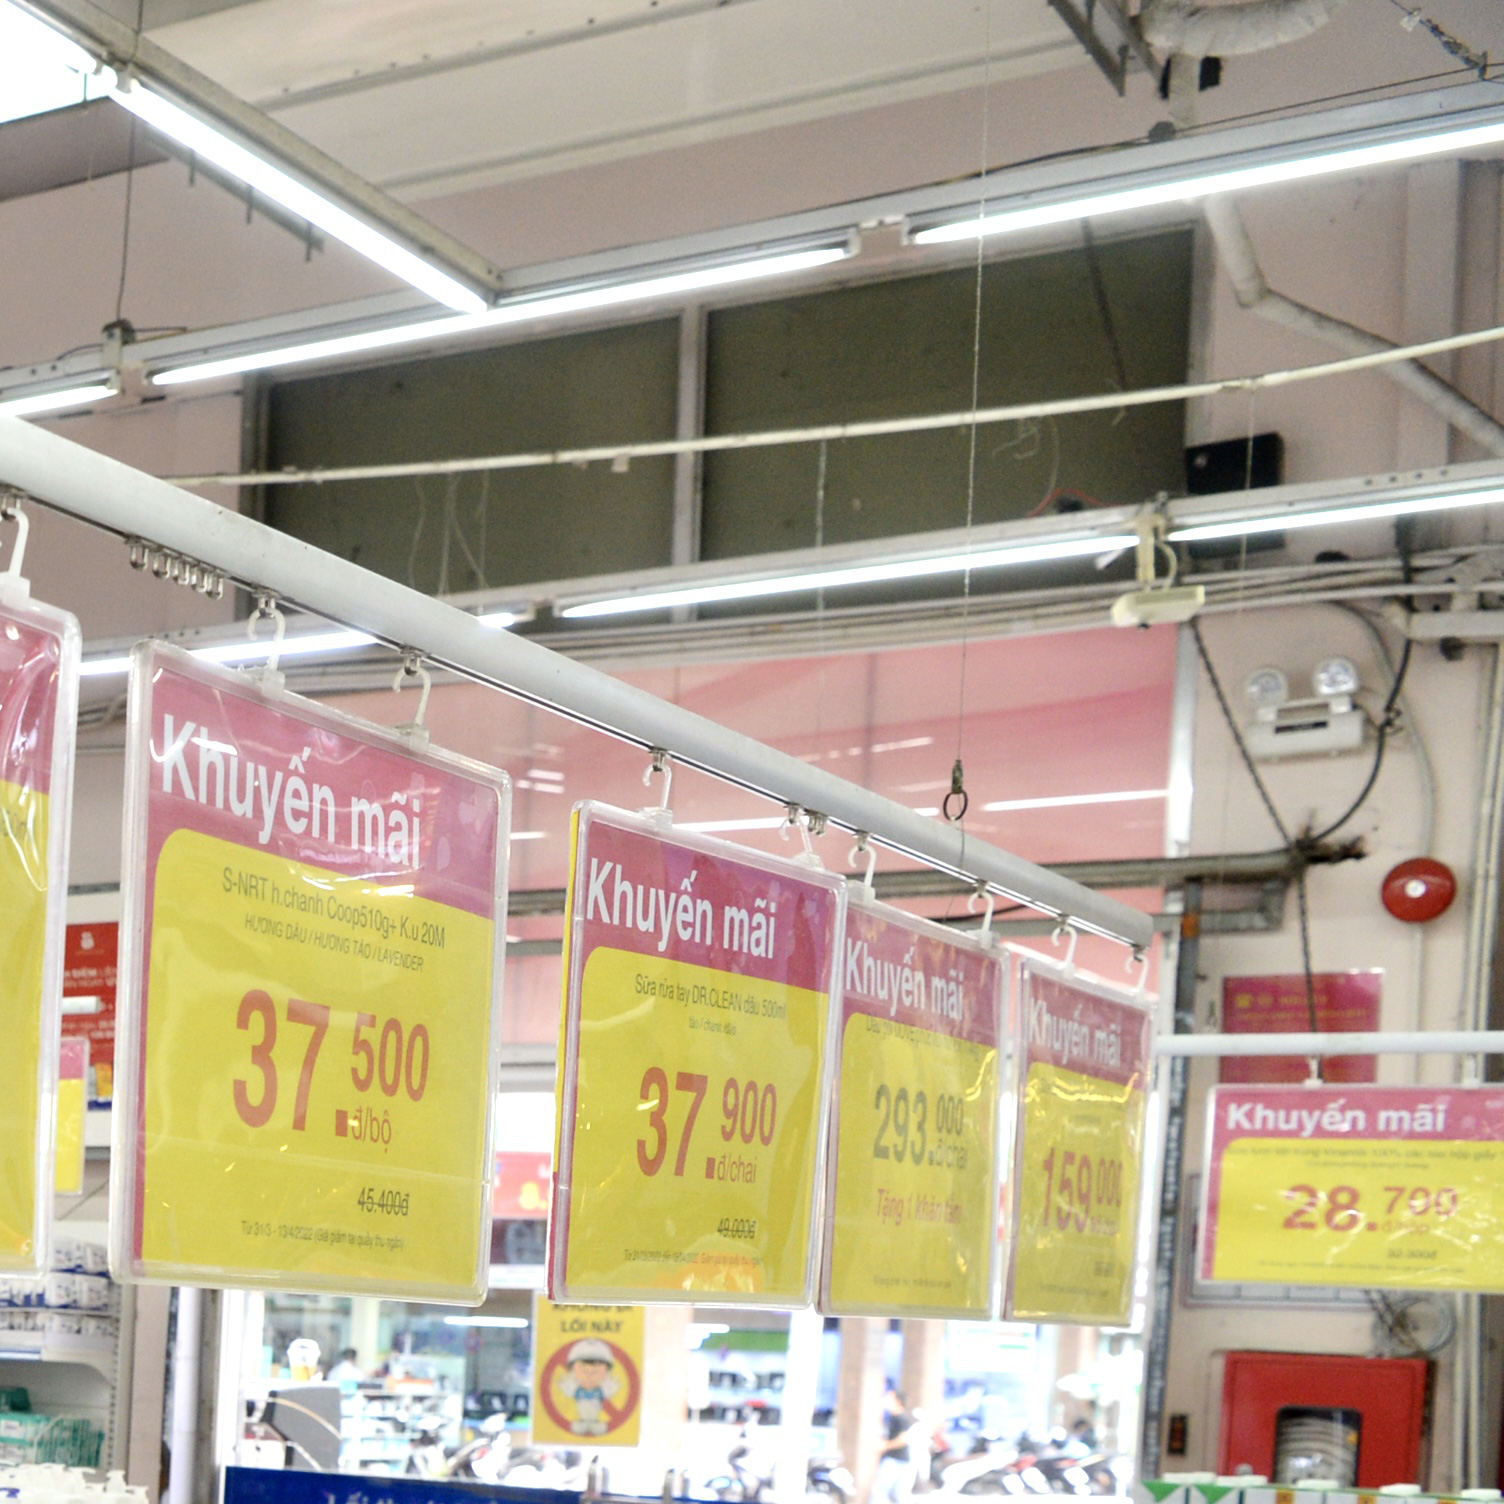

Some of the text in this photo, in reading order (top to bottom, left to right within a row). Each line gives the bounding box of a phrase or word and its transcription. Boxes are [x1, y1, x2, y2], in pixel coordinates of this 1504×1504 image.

[163, 713, 420, 868] Khuyến mãi
[222, 866, 268, 902] S-NRT
[271, 880, 324, 917] h.chanh
[586, 856, 776, 960] Khuyến mãi
[378, 942, 424, 973] LAVENDER
[845, 936, 965, 1021] Khuyến mãi
[635, 974, 656, 996] Sữa
[676, 984, 690, 1007] tay
[692, 985, 742, 1012] DR.CLEAN
[1029, 998, 1085, 1064] Khuyến
[1091, 1021, 1121, 1067] mãi
[233, 988, 430, 1138] 37.500
[352, 1106, 392, 1154] đ/bộ
[637, 1066, 776, 1180] 37.900
[717, 1152, 757, 1184] đ/chai
[1226, 1098, 1447, 1137] Khuyến mãi
[358, 1187, 409, 1216] 45.400đ
